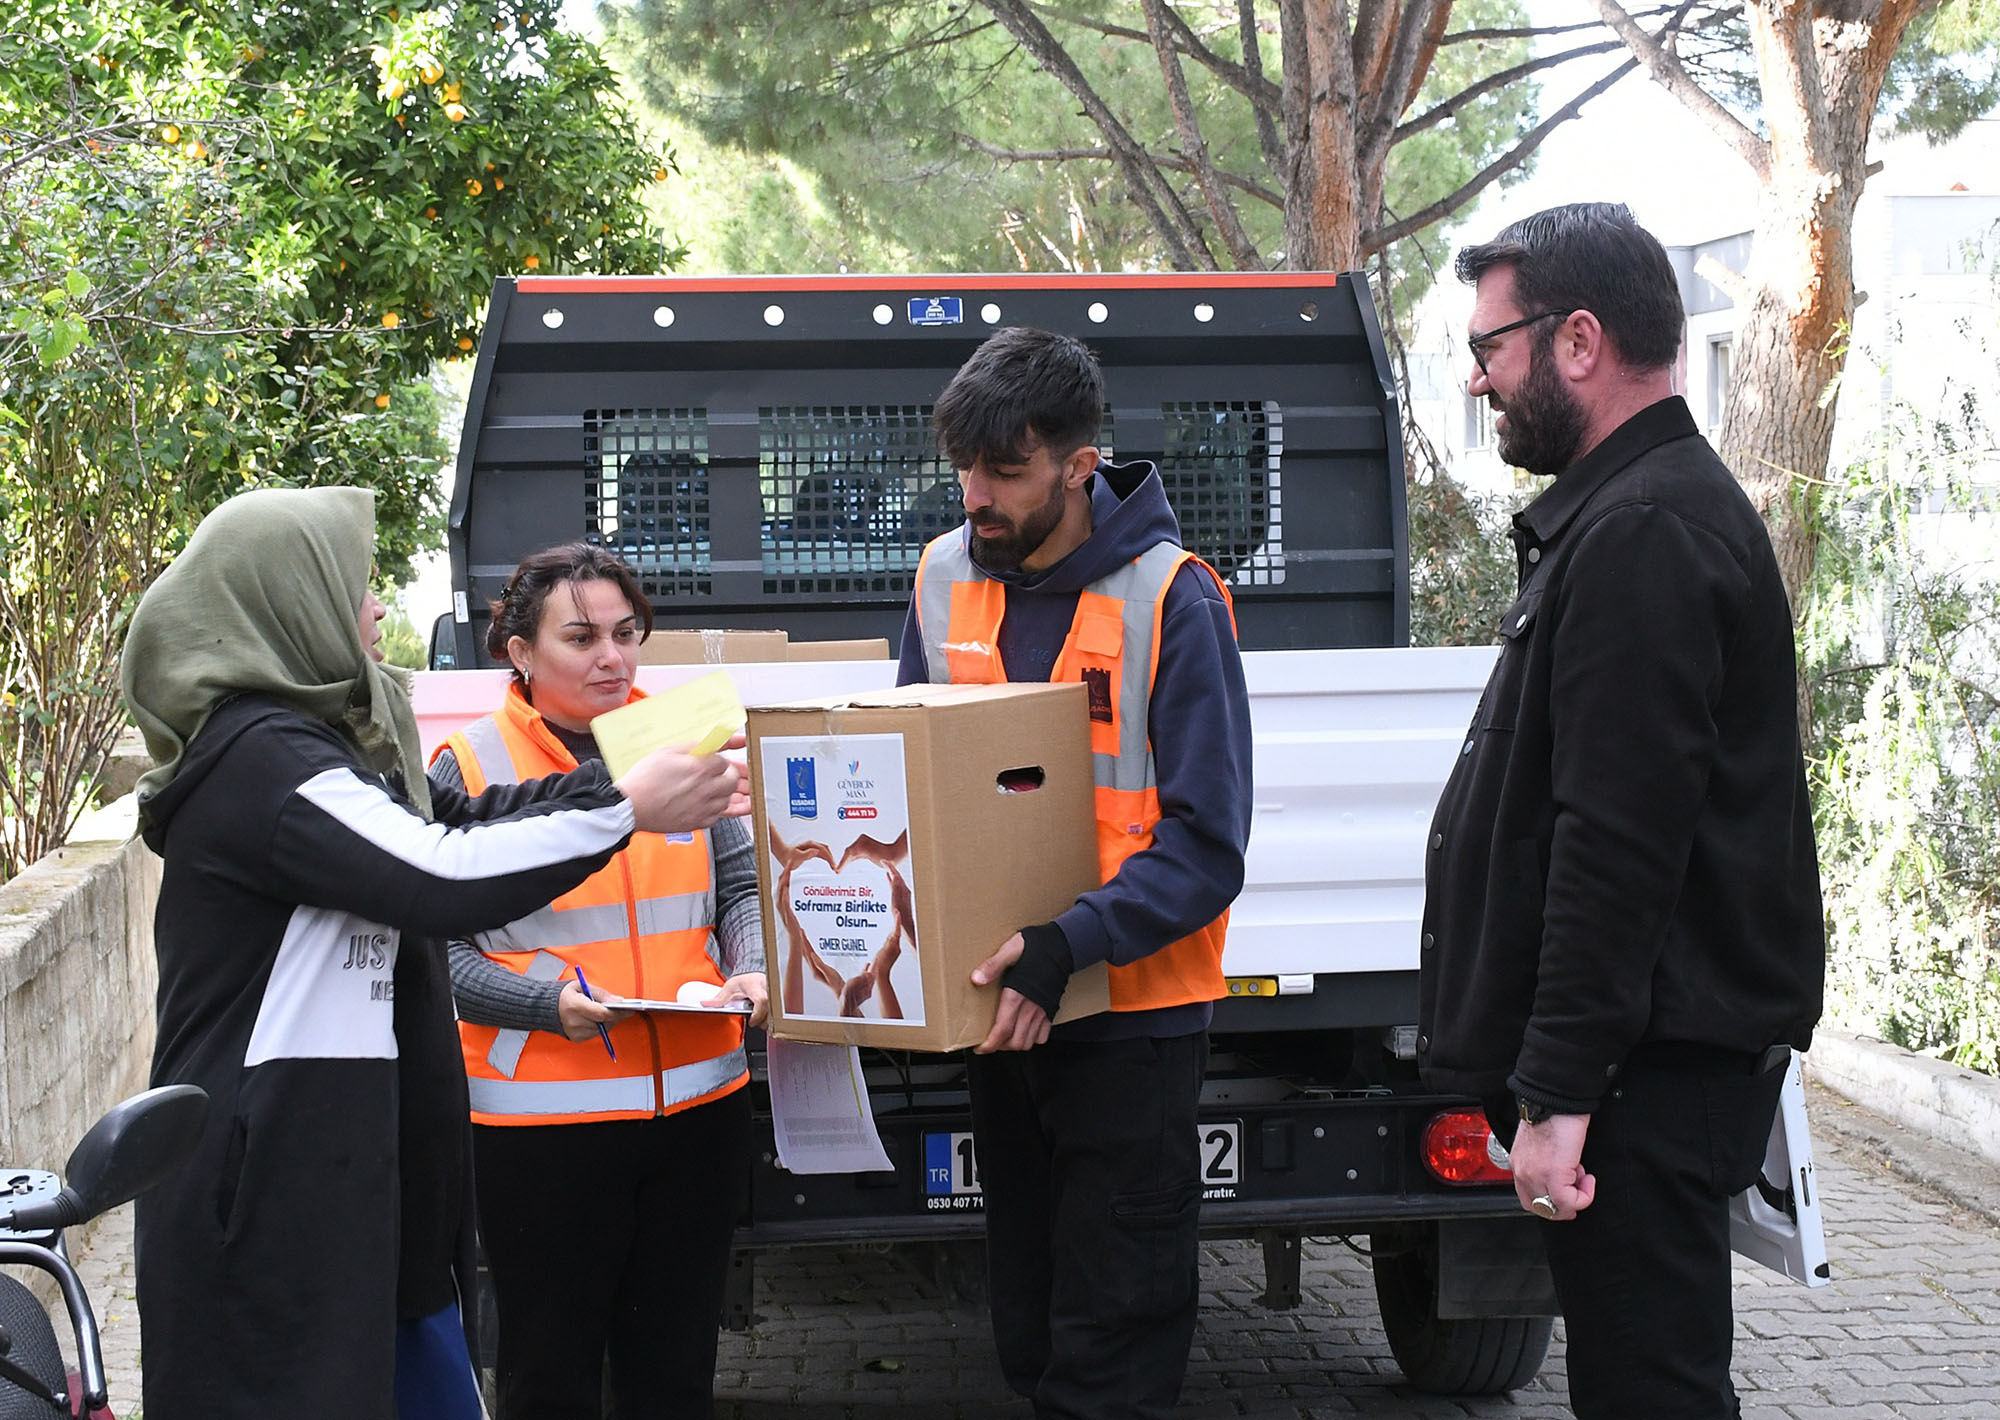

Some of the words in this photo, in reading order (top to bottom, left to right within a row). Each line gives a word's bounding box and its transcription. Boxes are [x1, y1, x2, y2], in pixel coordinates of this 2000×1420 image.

[803, 886, 856, 897] Gönüllerimiz
[858, 886, 874, 898] Bir,
[794, 899, 842, 912] Soframız
[845, 900, 888, 913] Birlikte
[835, 915, 878, 928] Olsun...
[342, 934, 386, 970] JUS
[370, 980, 394, 1001] NE
[929, 1168, 949, 1182] TR
[957, 1138, 974, 1188] 1
[1205, 1129, 1233, 1179] 2
[927, 1198, 951, 1209] 0530
[952, 1197, 970, 1208] 407
[1202, 1187, 1237, 1199] aratır.
